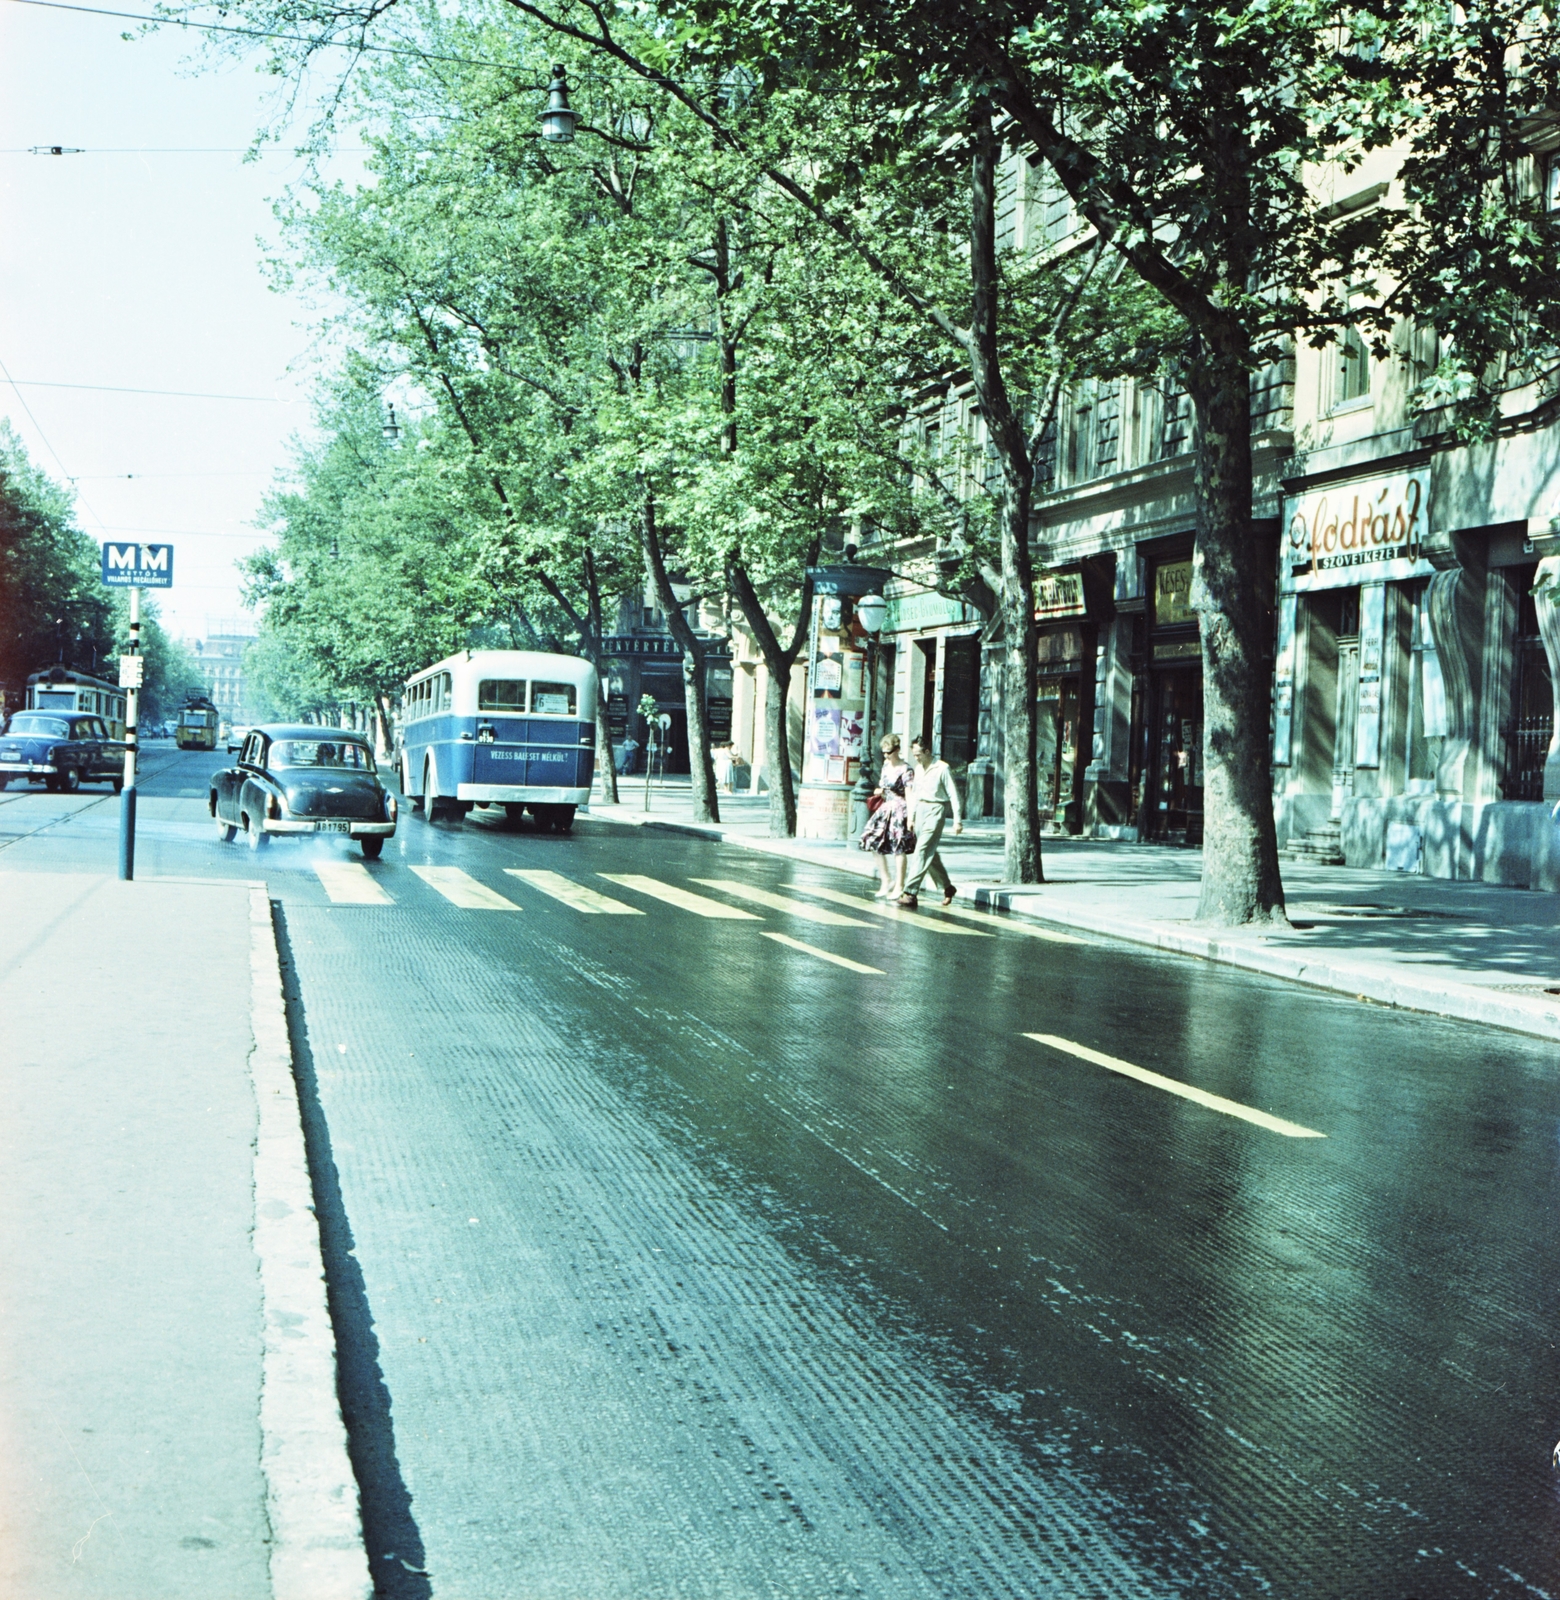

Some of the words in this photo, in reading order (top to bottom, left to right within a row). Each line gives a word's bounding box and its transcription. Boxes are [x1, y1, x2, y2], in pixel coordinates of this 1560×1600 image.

[1307, 478, 1421, 579] fodrász
[1322, 547, 1399, 569] SZÖVETKEZET
[107, 575, 132, 583] VILLAMOS
[539, 697, 545, 708] 6
[490, 750, 513, 760] VEZESS
[514, 751, 541, 762] BALESET
